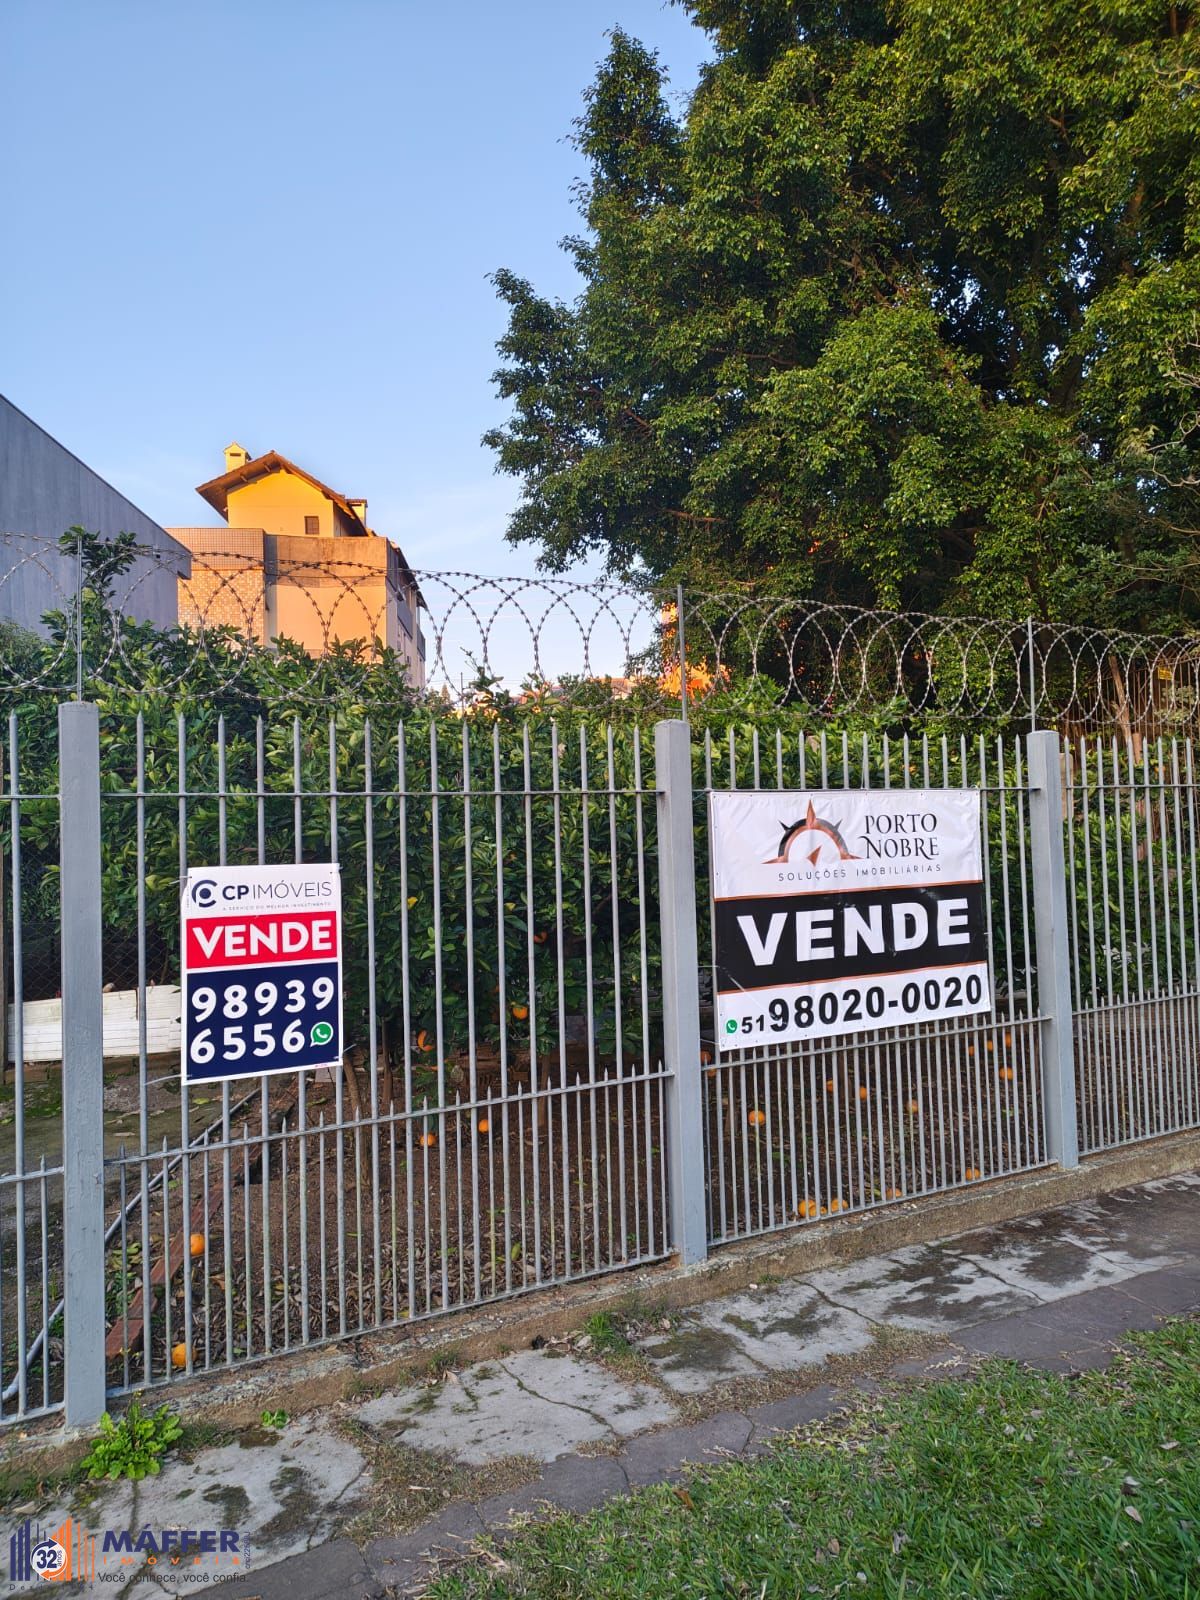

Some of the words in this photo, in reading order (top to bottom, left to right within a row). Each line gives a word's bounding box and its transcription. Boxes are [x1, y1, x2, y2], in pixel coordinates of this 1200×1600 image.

[864, 813, 938, 834] PORTO
[859, 836, 940, 860] NOBRE
[778, 869, 847, 882] SOLUÇÕES
[856, 864, 941, 877] IMOBILIÁRIAS
[192, 919, 332, 960] VENDE
[737, 898, 971, 967] VENDE
[191, 976, 335, 1023] 98939
[741, 1014, 765, 1034] 51
[768, 974, 982, 1032] 98020-0020
[190, 1018, 306, 1064] 6556
